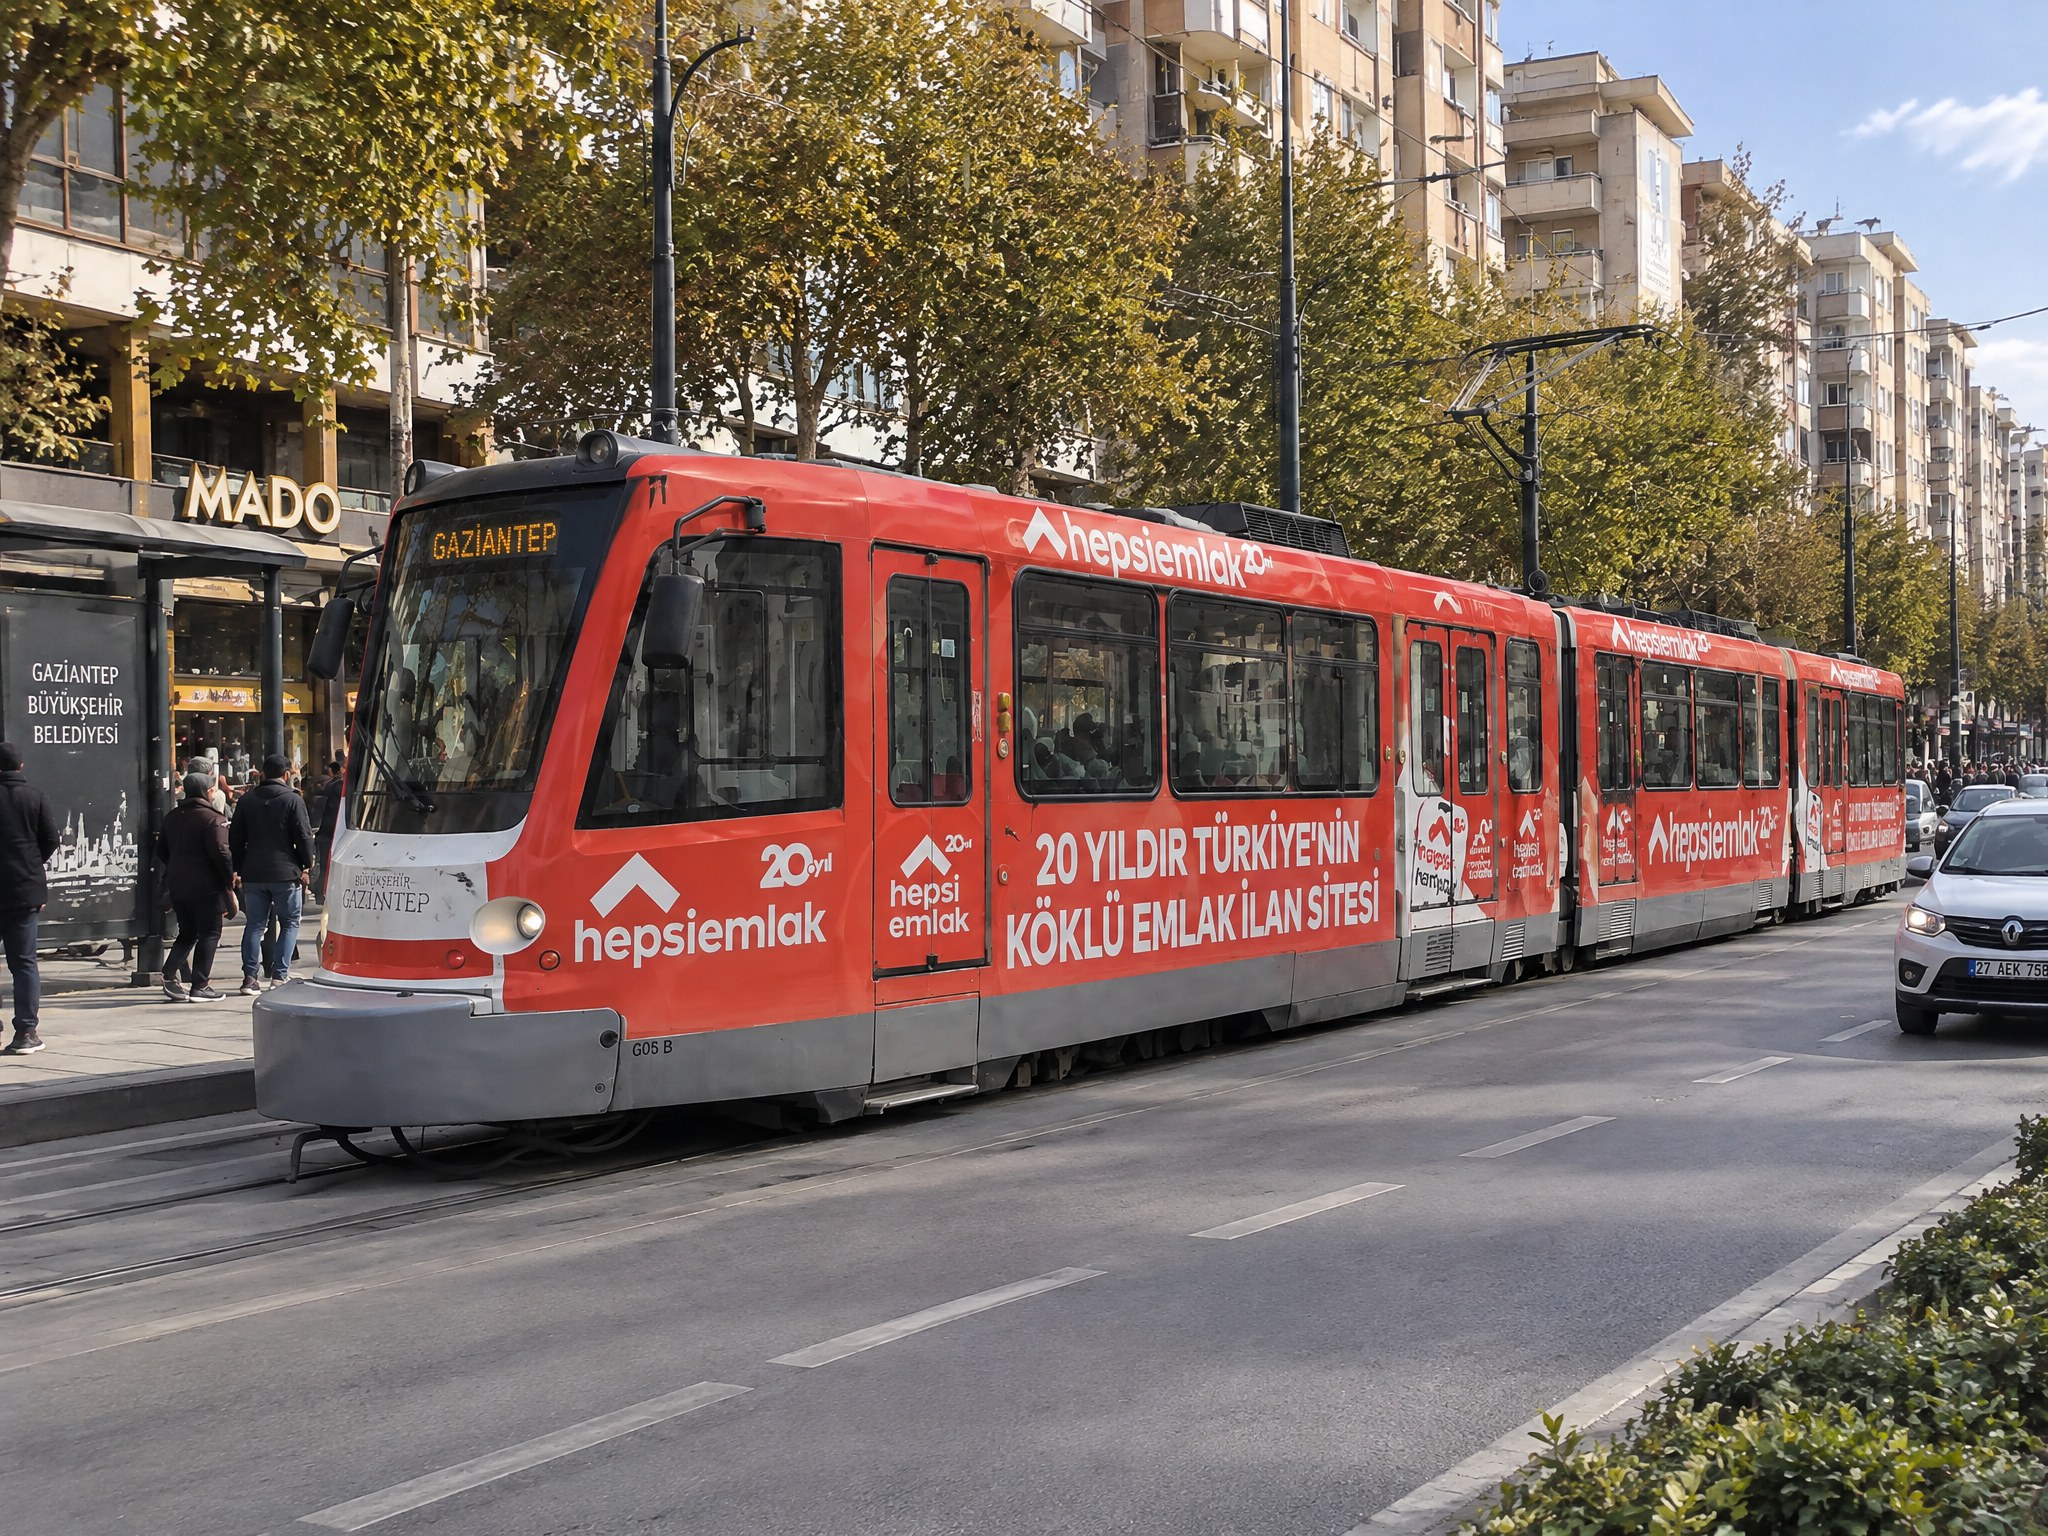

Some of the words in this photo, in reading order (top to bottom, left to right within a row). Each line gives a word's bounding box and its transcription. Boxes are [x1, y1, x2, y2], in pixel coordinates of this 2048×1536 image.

[182, 462, 341, 534] MADO
[433, 522, 557, 560] GAZİANTEP
[1062, 511, 1247, 589] hepsiemlak
[32, 659, 119, 685] GAZİANTEP
[28, 688, 123, 721] BÜYÜKŞEHİR
[34, 723, 118, 744] BELEDİYESİ
[1035, 832, 1078, 886] 20
[1083, 829, 1189, 882] YILDIR
[1193, 807, 1360, 875] TÜRKİYE'NİN
[1669, 809, 1760, 873] hepsiemlak
[890, 873, 960, 911] hepsi
[574, 901, 827, 969] hepsiemlak
[889, 906, 970, 938] emlak
[1006, 889, 1125, 970] KÖKLÜ
[1132, 893, 1237, 954] EMLAK
[1241, 877, 1303, 939] İLAN
[1306, 866, 1380, 931] SİTESİ
[1976, 962, 1991, 975] 27
[1997, 963, 2021, 976] AEK
[663, 1040, 673, 1054] B
